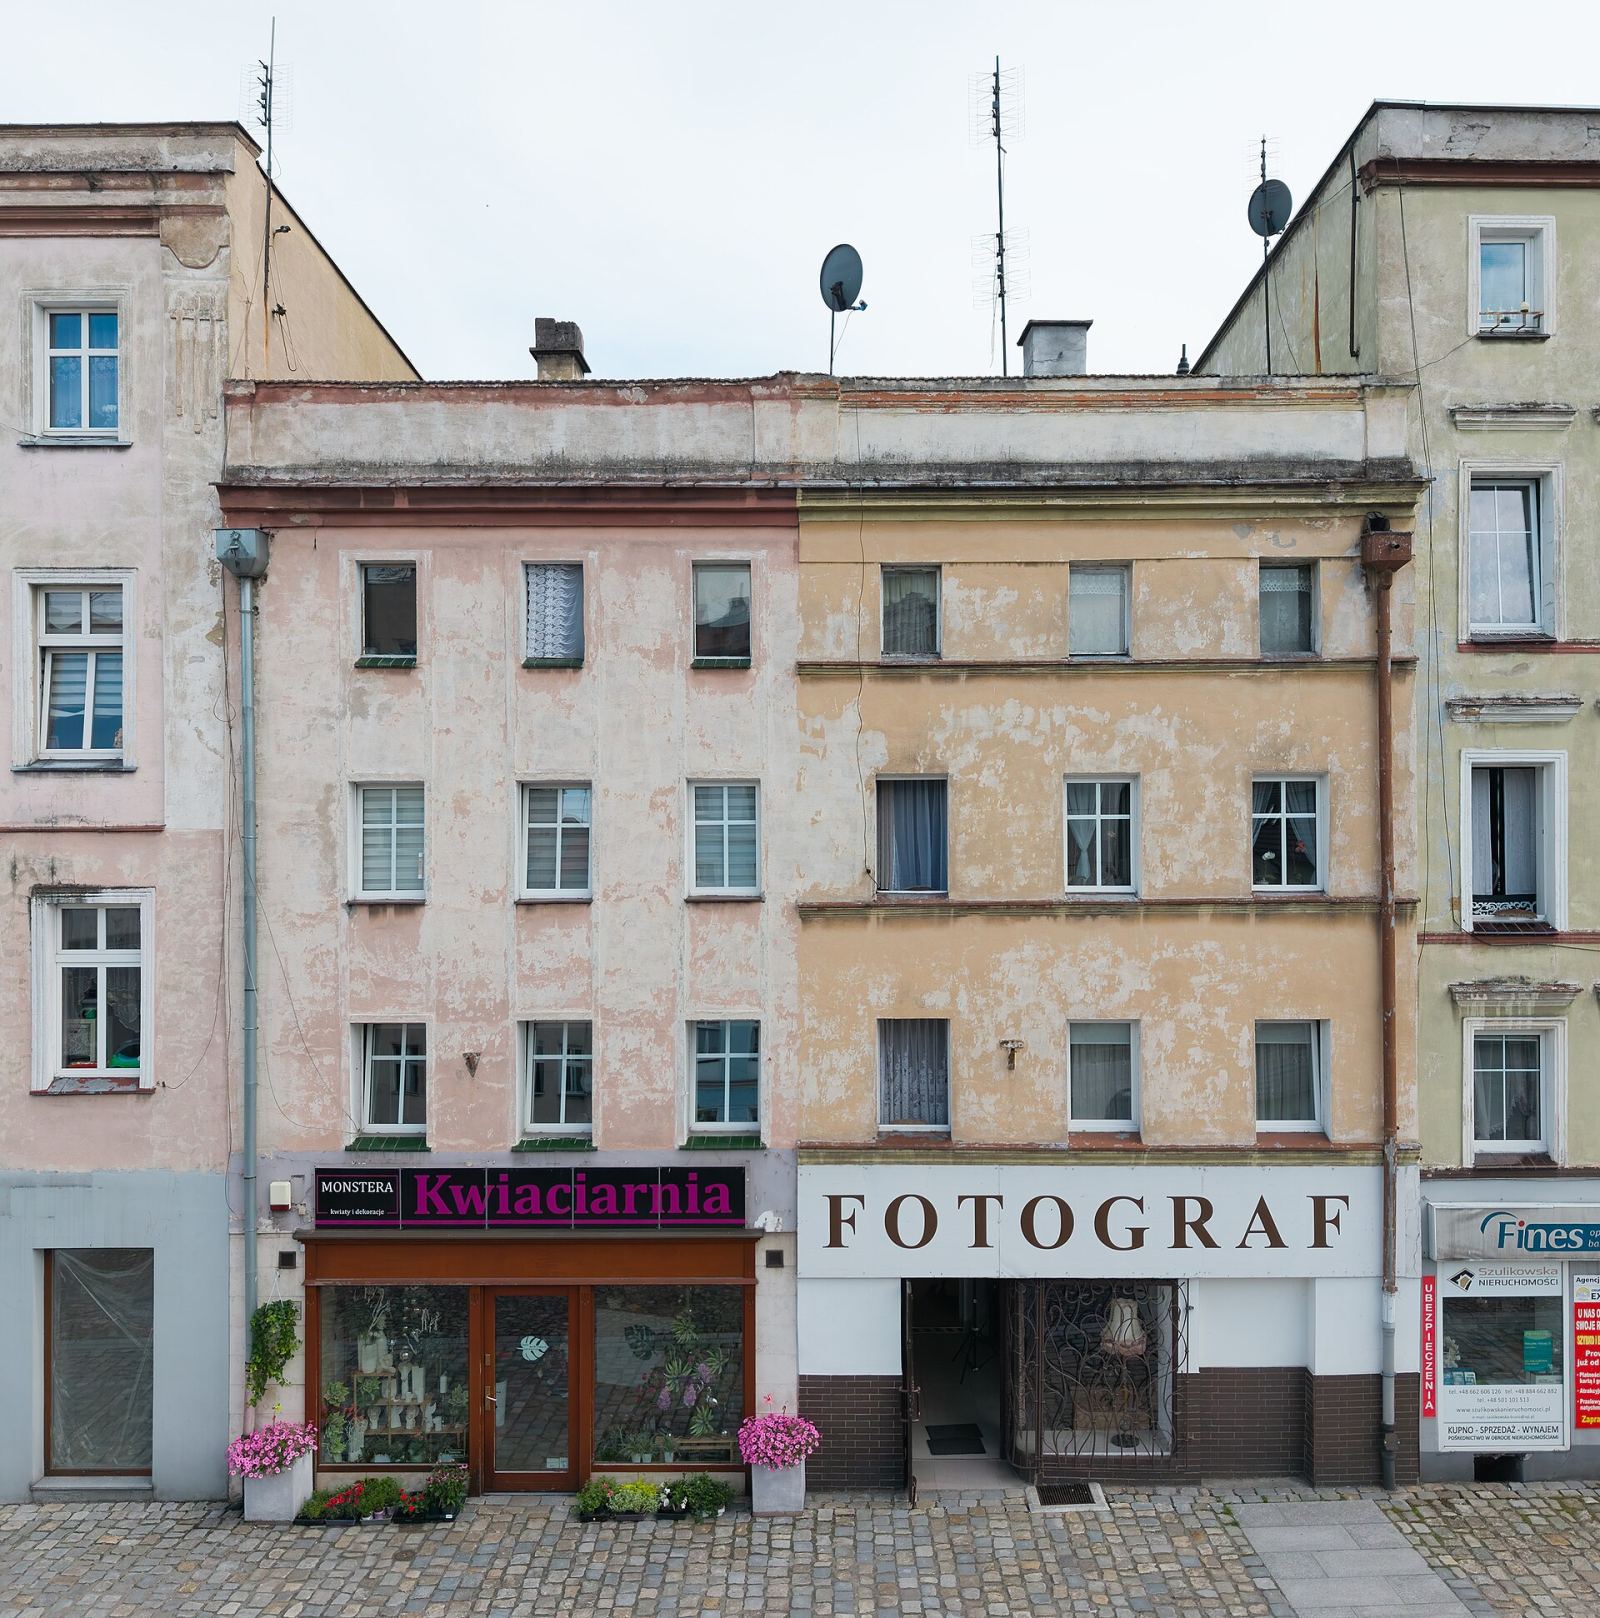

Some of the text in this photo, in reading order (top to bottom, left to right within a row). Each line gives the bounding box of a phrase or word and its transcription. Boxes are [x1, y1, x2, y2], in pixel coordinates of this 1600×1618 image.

[321, 1181, 394, 1193] MONSTERA
[413, 1172, 732, 1215] Kwiaciarnia
[330, 1208, 351, 1216] kwiaty
[355, 1208, 384, 1216] dekoracje
[821, 1194, 1350, 1251] FOTOGRAF
[1497, 1220, 1584, 1249] Fines
[1478, 1267, 1558, 1276] Szulikowska
[1478, 1278, 1558, 1286] NIERUCHOMOŚCI
[1578, 1308, 1582, 1318] U
[1583, 1308, 1595, 1318] NAS
[1576, 1320, 1596, 1330] SWOJE
[1424, 1284, 1434, 1410] UBEZPIECZENIA
[1577, 1358, 1588, 1367] już
[1448, 1426, 1474, 1434] KUPNO
[1480, 1425, 1516, 1434] SPRZEDAŻ
[1522, 1426, 1559, 1434] WYNAJEM
